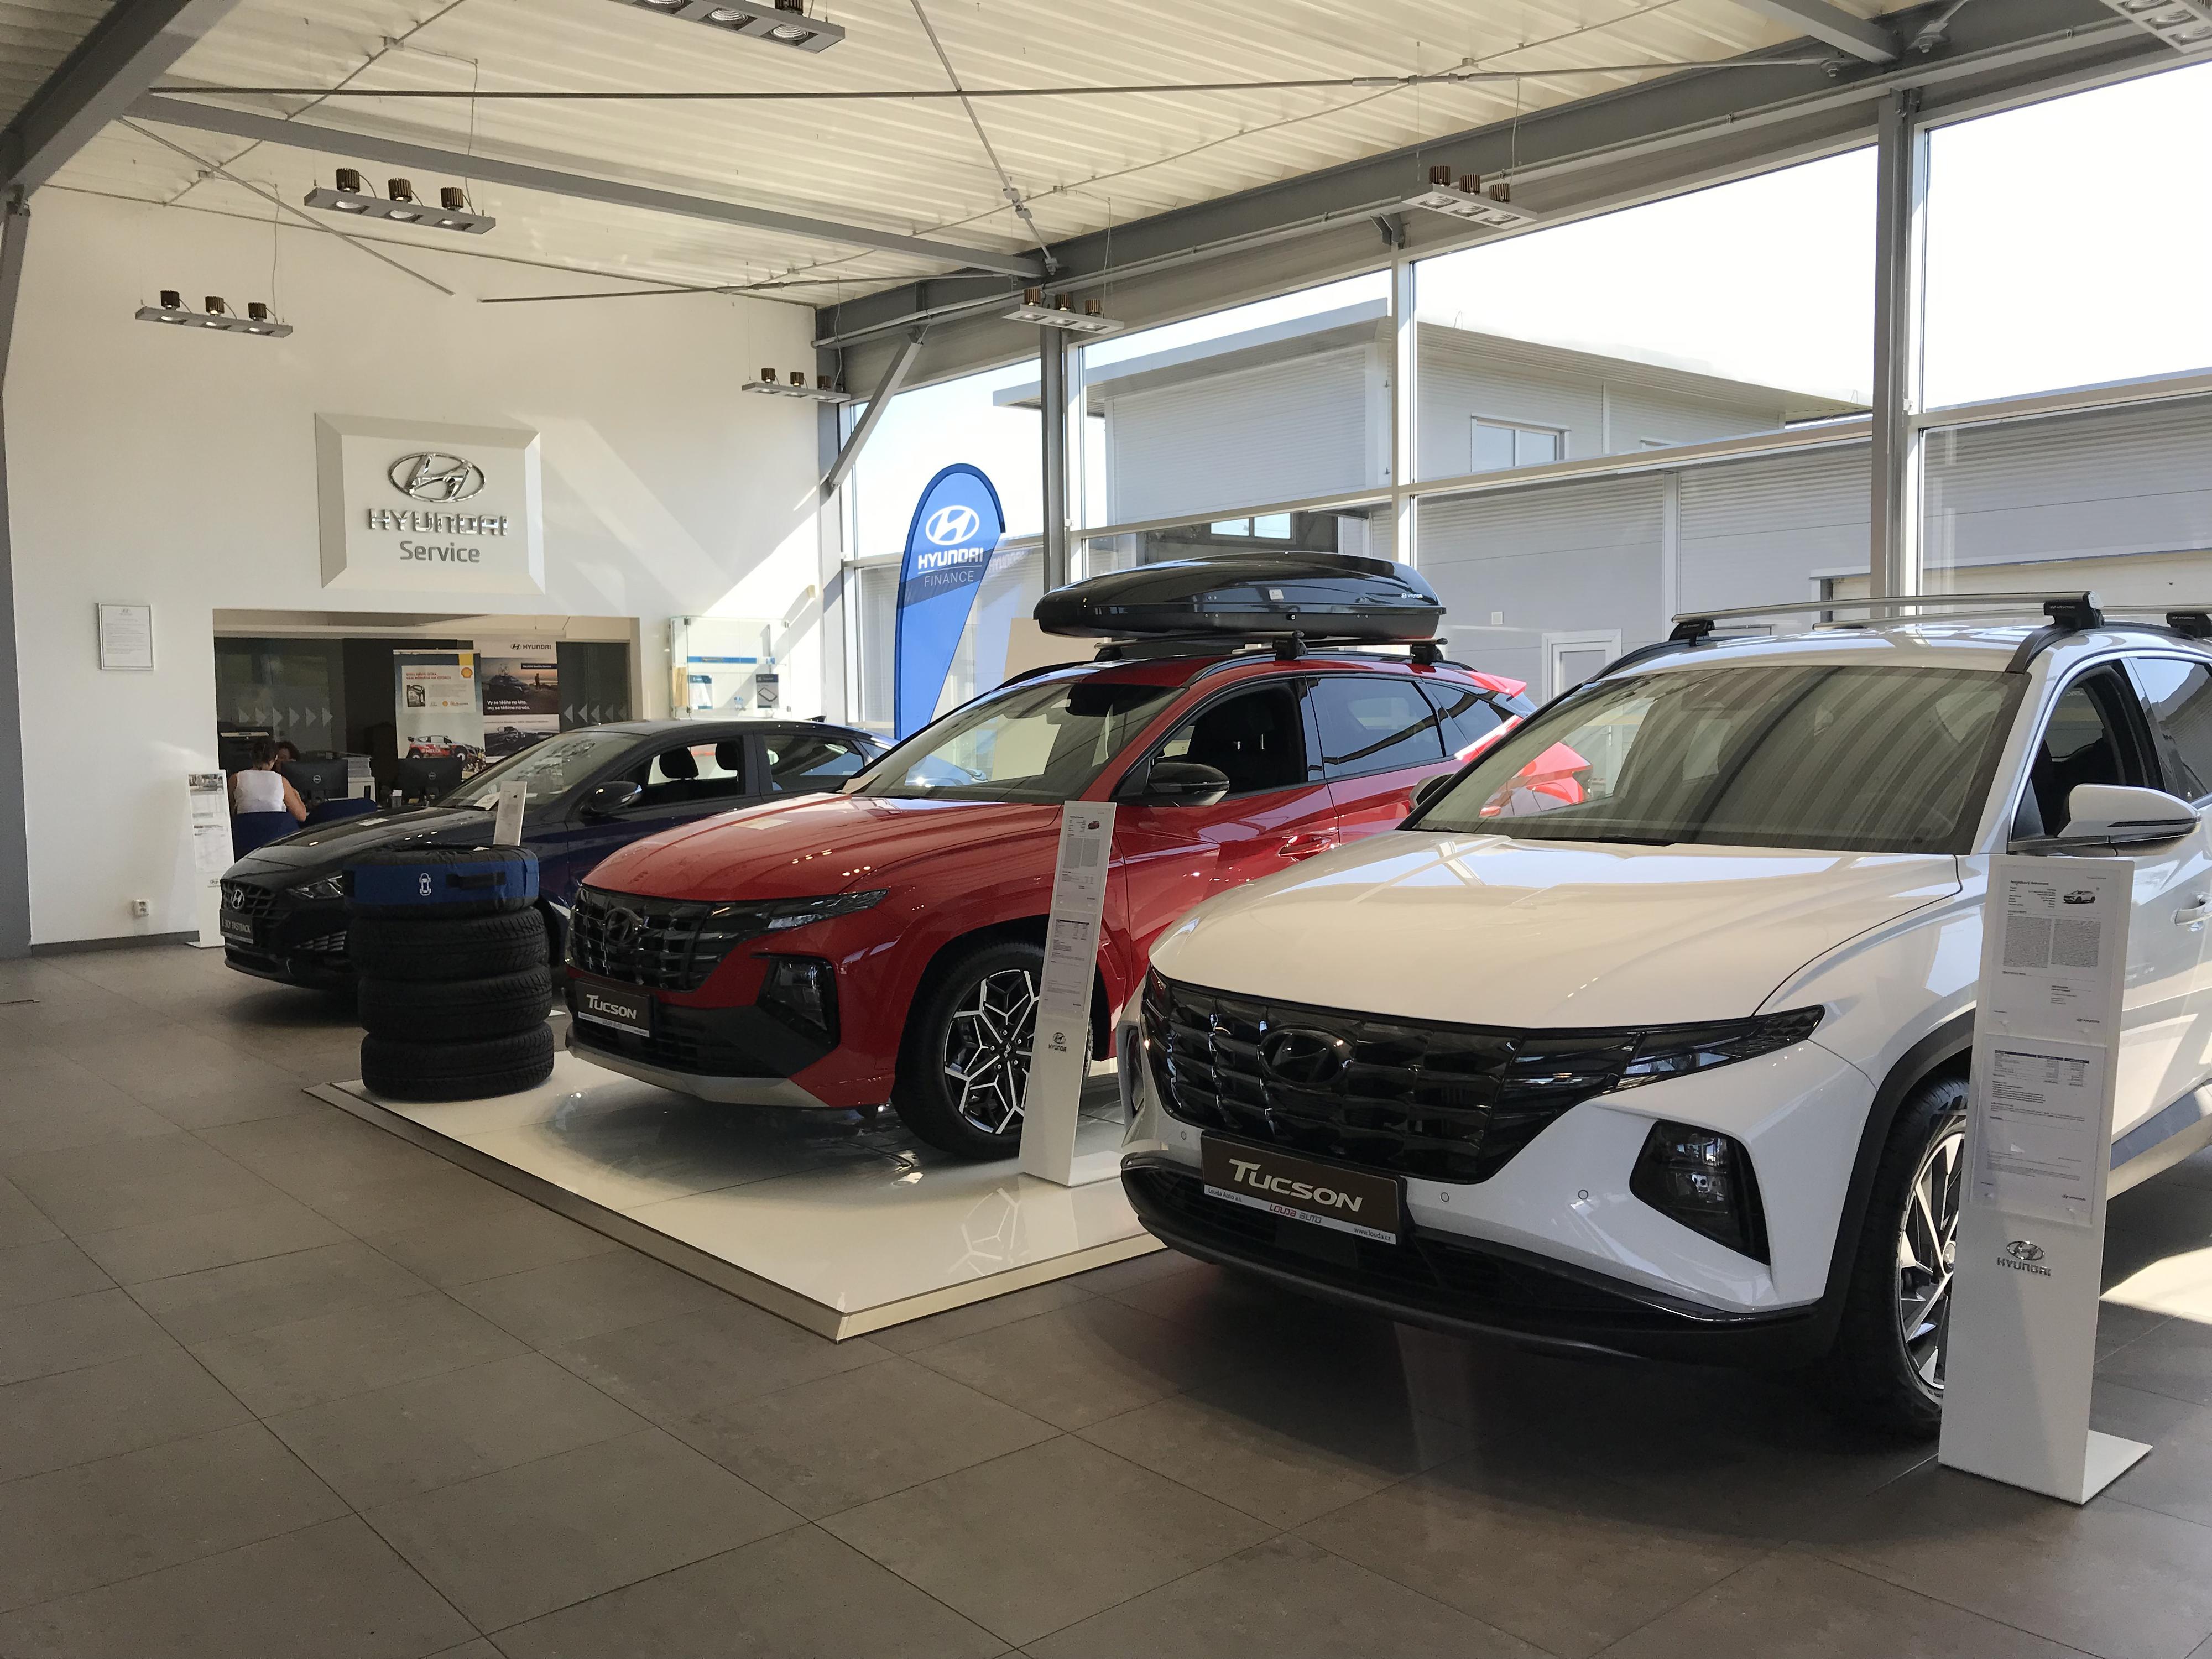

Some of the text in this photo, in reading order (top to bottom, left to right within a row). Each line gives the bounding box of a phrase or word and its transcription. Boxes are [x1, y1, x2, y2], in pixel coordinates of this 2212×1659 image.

[368, 508, 508, 535] HYUNDAI
[400, 540, 480, 563] Service
[917, 547, 984, 570] HYUNDAI
[924, 571, 974, 587] FINANCE
[1048, 1044, 1067, 1052] HYUNDA
[1208, 1187, 1222, 1197] Louda
[1223, 1192, 1234, 1200] Auto
[1354, 1227, 1391, 1241] www.louda.cz
[1997, 1257, 2051, 1277] HYUNDAI
